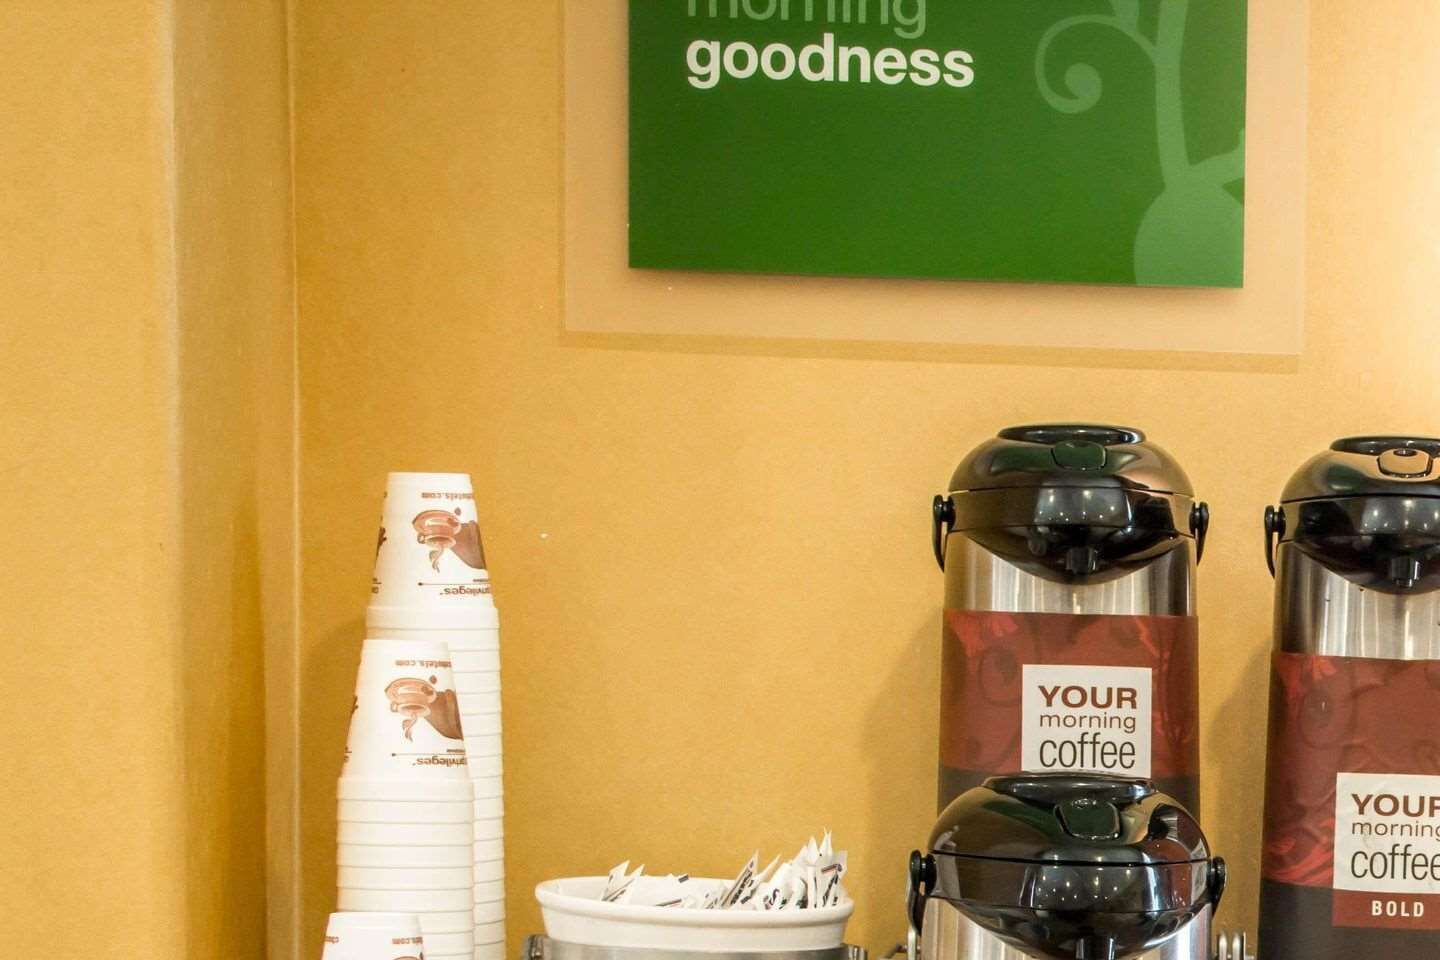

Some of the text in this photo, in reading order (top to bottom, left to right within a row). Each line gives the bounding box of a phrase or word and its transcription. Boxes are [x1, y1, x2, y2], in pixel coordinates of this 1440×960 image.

[686, 32, 975, 89] goodness
[1038, 685, 1137, 709] YOUR
[1039, 712, 1136, 734] morning
[1039, 732, 1136, 769] coffee
[1371, 900, 1425, 917] BOLD
